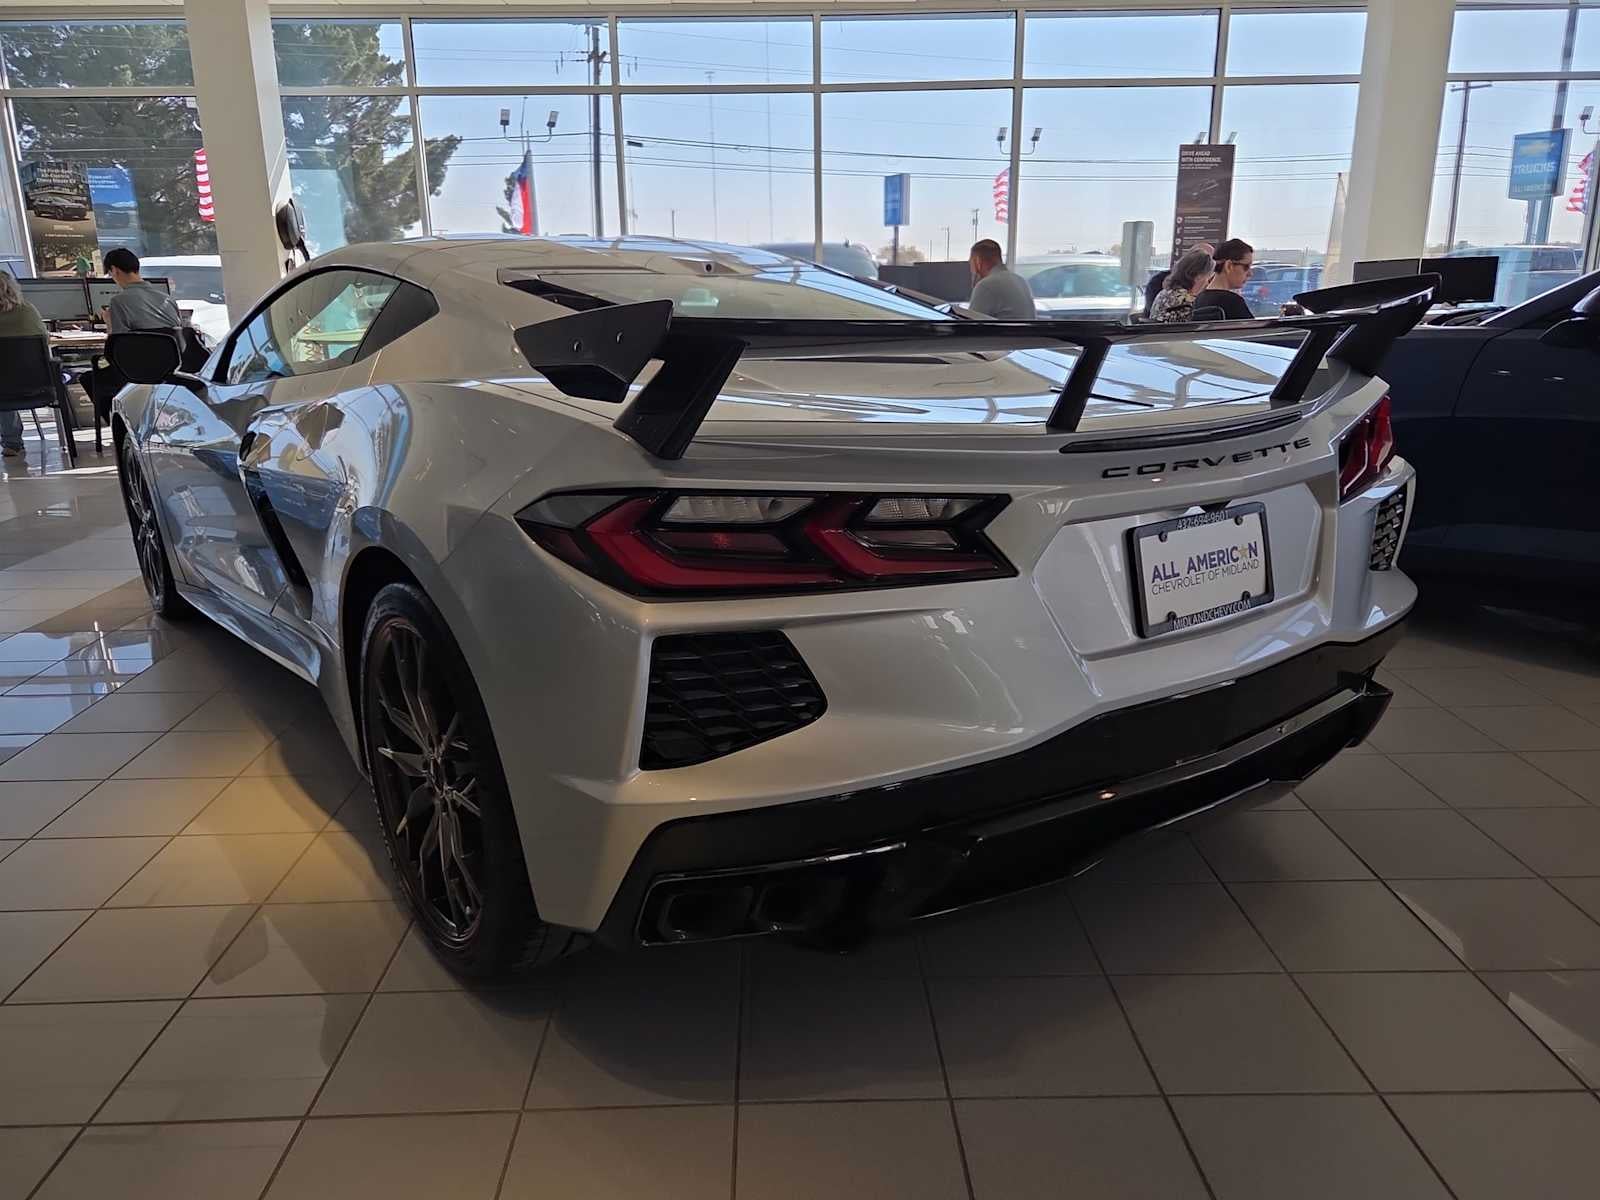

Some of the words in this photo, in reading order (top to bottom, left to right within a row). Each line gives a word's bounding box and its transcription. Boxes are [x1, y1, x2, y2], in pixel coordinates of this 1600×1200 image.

[1101, 437, 1312, 479] CORVETTE
[1151, 561, 1180, 584] ALL
[1151, 571, 1206, 595] CHEVROLET
[1207, 569, 1220, 582] OF
[1222, 558, 1260, 578] MIDLAND
